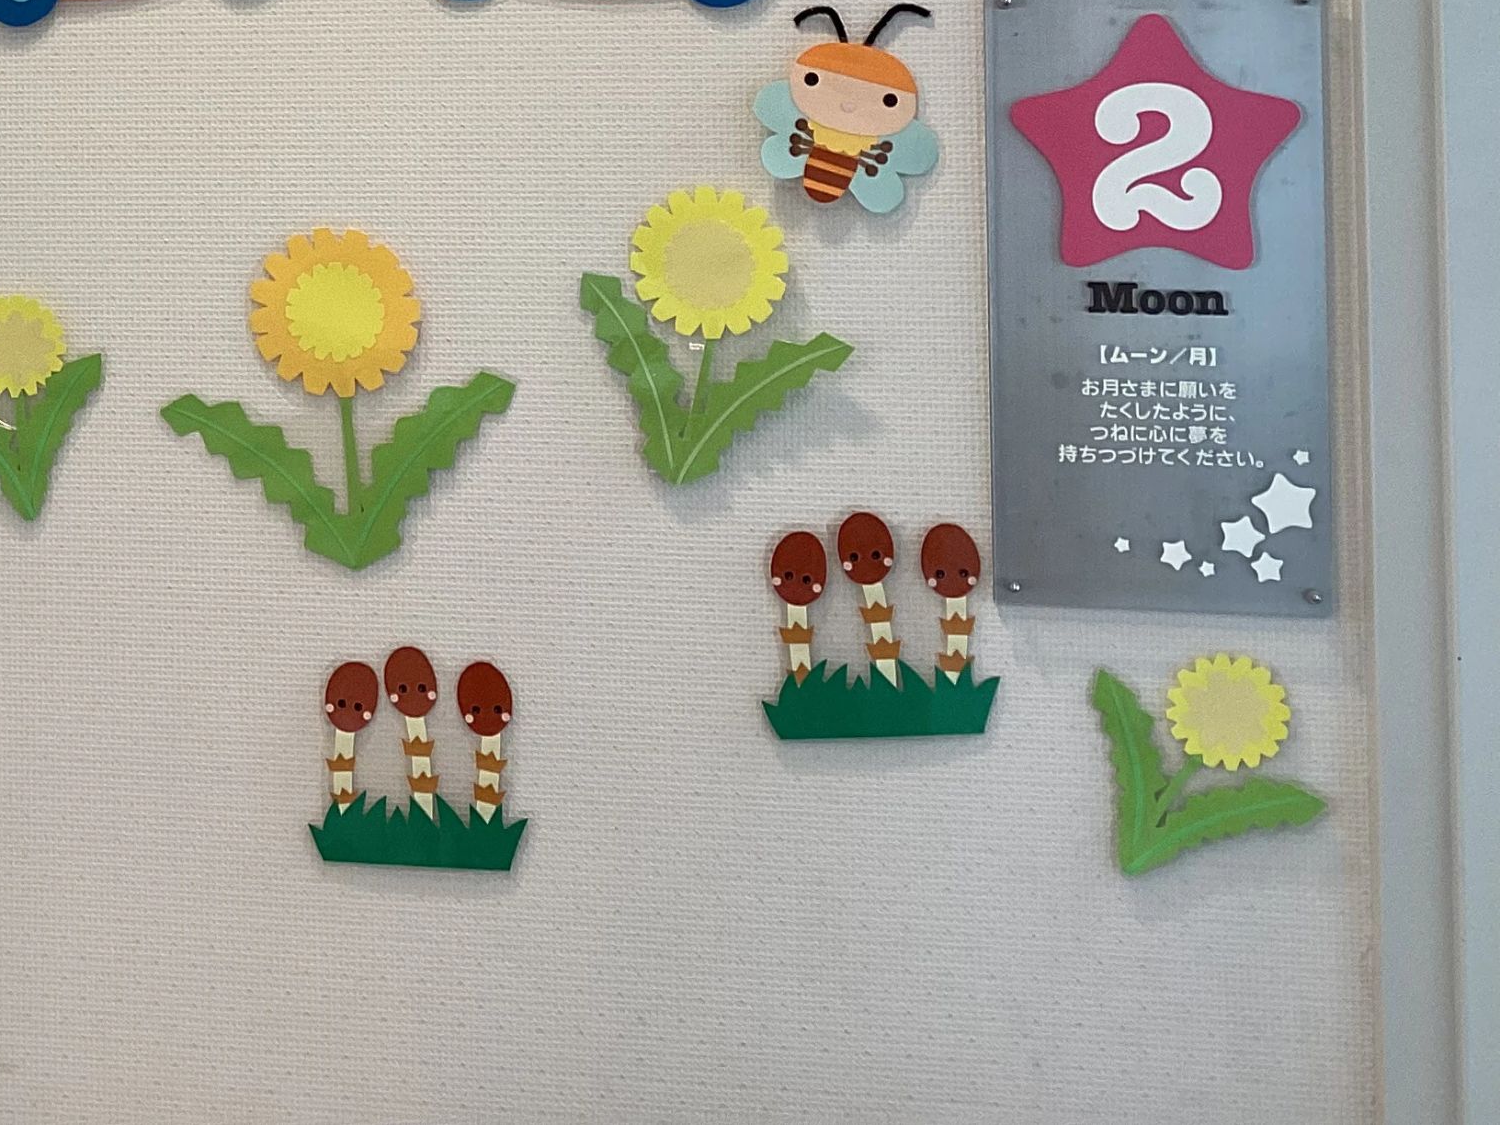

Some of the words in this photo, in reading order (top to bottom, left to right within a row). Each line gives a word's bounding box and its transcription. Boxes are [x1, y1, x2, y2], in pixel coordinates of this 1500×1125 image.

[1092, 82, 1223, 231] 2
[1087, 282, 1229, 316] Moon
[1081, 379, 1236, 399] お月さまに願いを
[1100, 402, 1236, 422] たくしたように、
[1090, 424, 1227, 444] つねに心に夢を
[1058, 444, 1264, 468] 持ちつづけてください。
